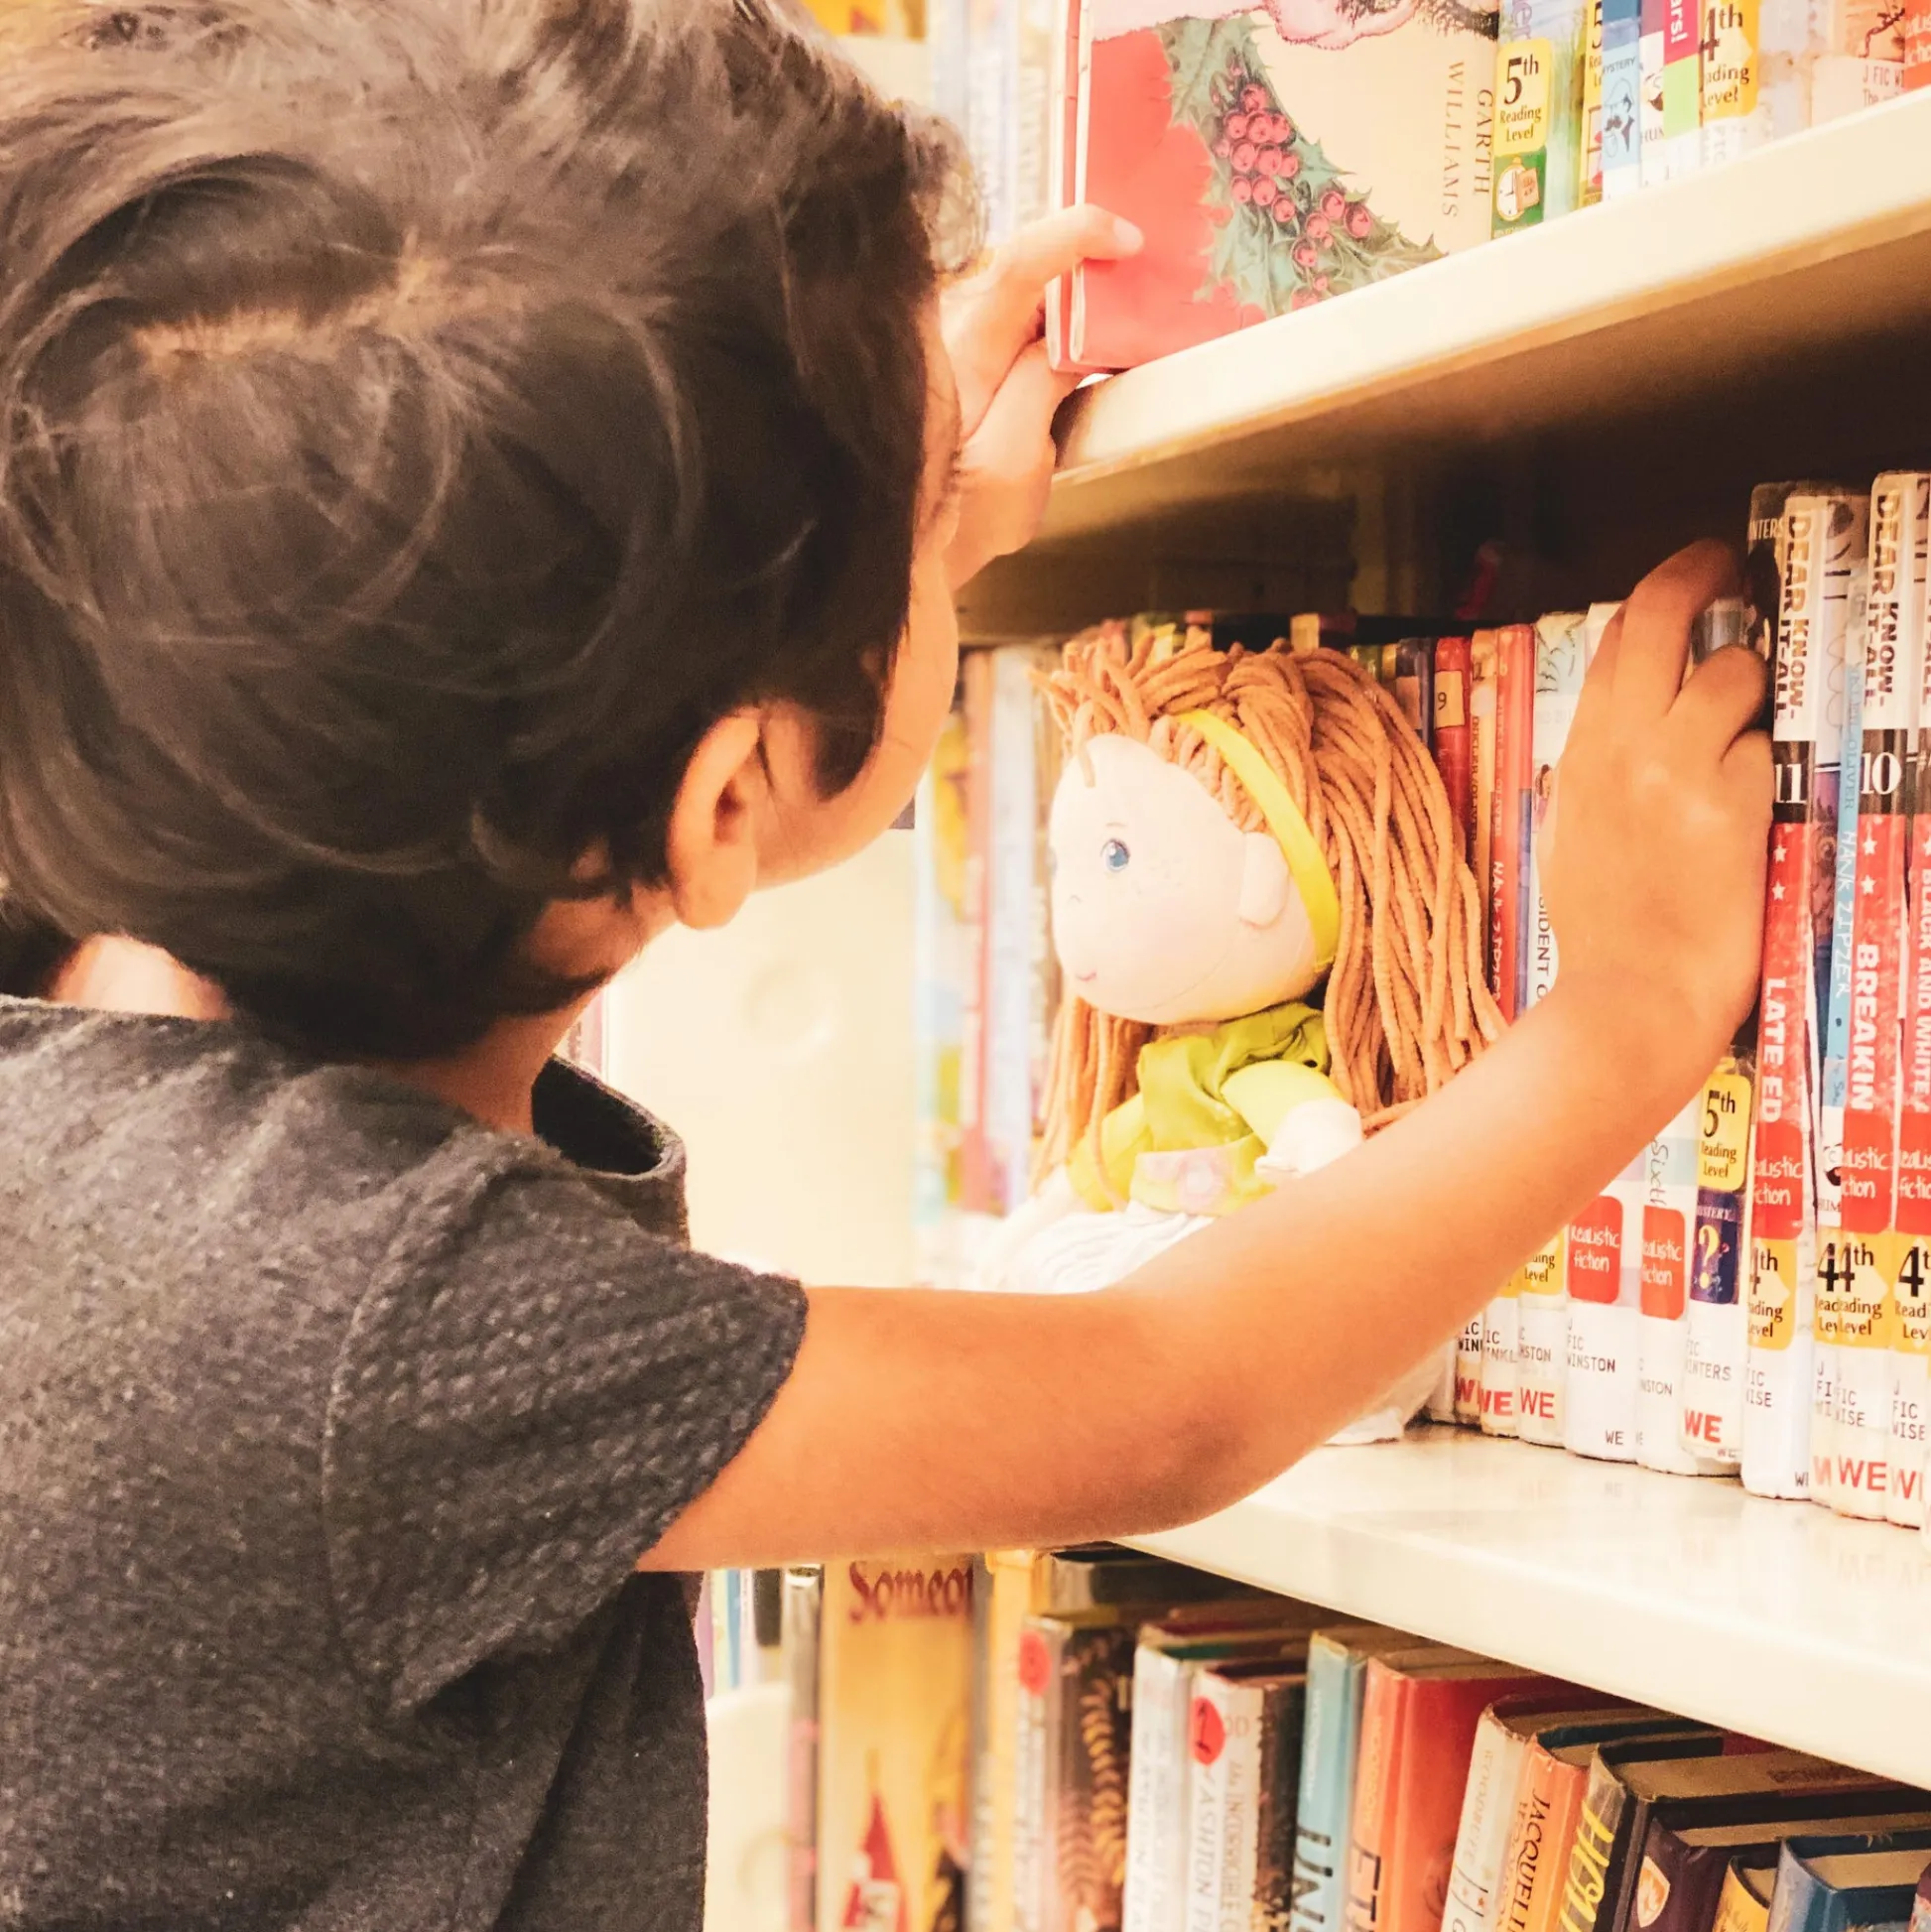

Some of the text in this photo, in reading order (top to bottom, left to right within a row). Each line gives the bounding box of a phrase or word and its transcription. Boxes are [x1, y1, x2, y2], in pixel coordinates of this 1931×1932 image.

[1503, 55, 1539, 105] 5th
[1603, 57, 1635, 74] YSTERY
[1500, 105, 1542, 123] Reading
[1443, 61, 1465, 217] WILLIAMS
[1474, 89, 1493, 194] GARTH
[1506, 126, 1534, 142] Level
[1861, 752, 1902, 795] 10
[1836, 830, 1857, 997] HANK ZIPZER
[1763, 976, 1788, 1067] LATE
[1851, 944, 1881, 1111] BREAKIN
[1704, 1090, 1736, 1138] 5th
[1524, 1269, 1549, 1283] Level
[1520, 1386, 1555, 1419] WE
[1893, 1399, 1919, 1421] FIC
[1606, 1430, 1624, 1447] WE
[1685, 1408, 1723, 1444] WE
[1838, 1454, 1887, 1492] WE
